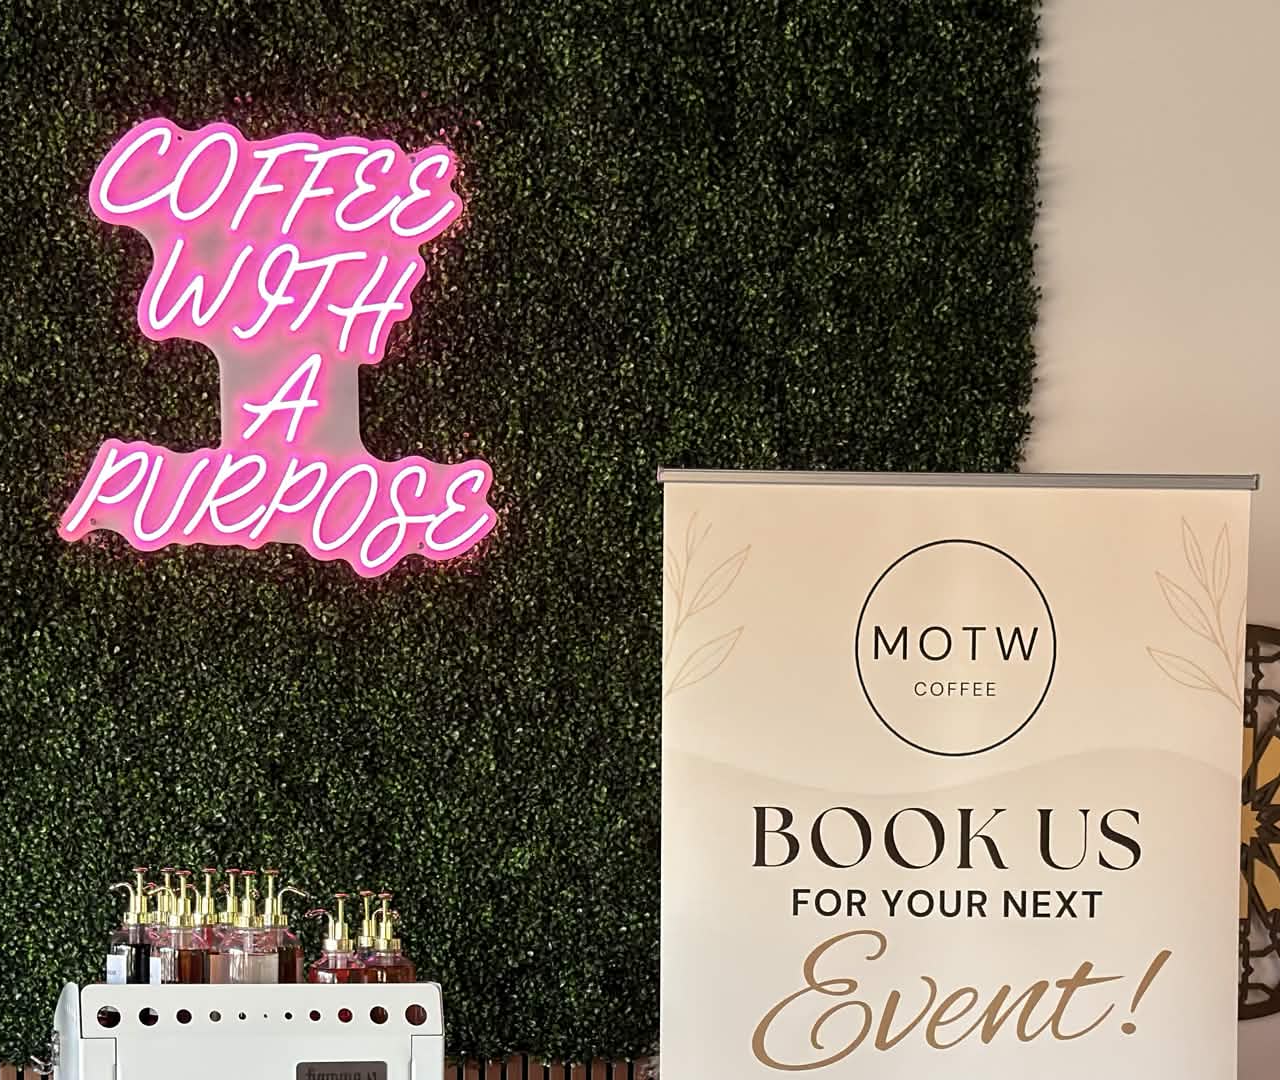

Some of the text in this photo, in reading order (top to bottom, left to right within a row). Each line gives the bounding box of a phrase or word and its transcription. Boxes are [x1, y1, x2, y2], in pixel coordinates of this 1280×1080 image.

[100, 127, 455, 236] COFFEE
[148, 239, 418, 354] WITH
[243, 354, 321, 442] A
[66, 448, 489, 568] PURPOSE
[873, 625, 1039, 661] MOTW
[914, 681, 996, 697] COFFEE
[752, 806, 1142, 871] BOOK US
[792, 888, 1103, 919] FOR YOUR NEXT
[751, 929, 1173, 1072] Event!
